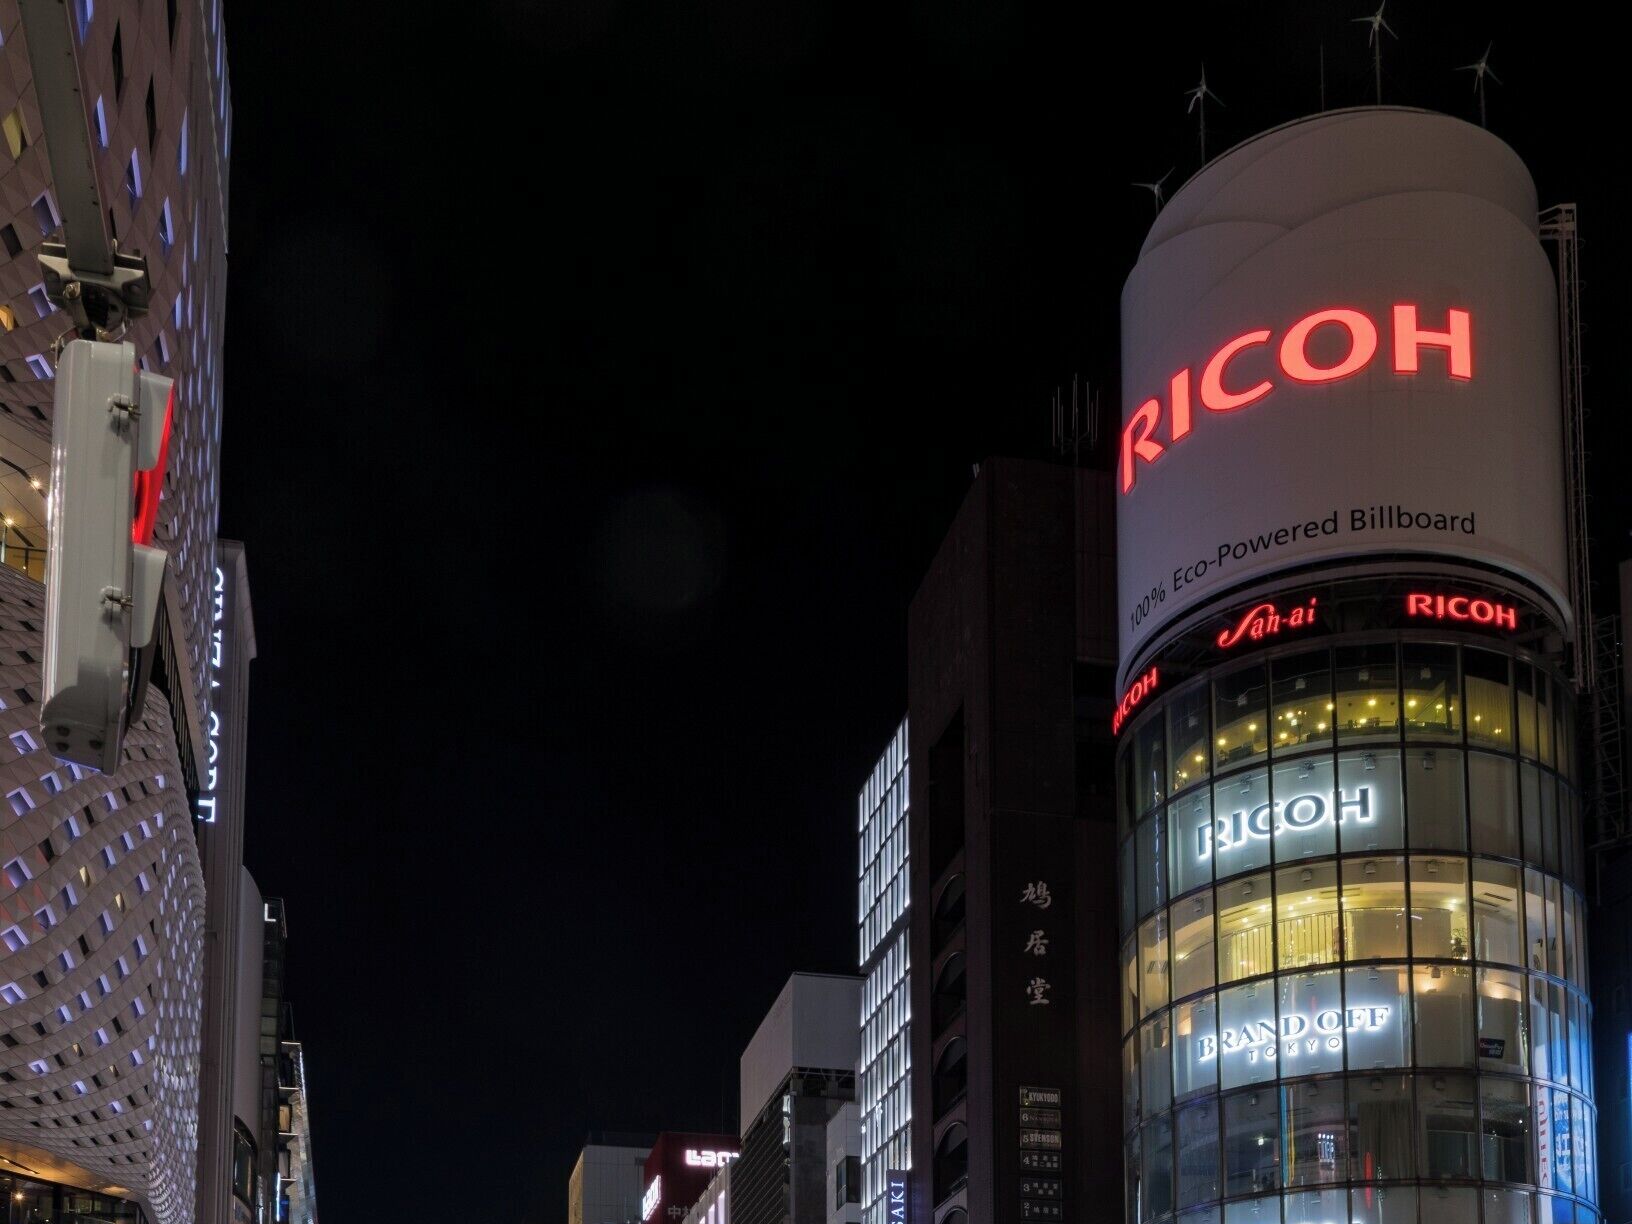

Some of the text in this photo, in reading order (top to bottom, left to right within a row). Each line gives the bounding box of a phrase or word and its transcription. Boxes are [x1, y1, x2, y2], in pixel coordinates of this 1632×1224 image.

[1121, 304, 1472, 496] RICOH
[1130, 506, 1476, 633] 100% Eco-Powered Billboard
[1408, 593, 1517, 630] RICOH
[1112, 666, 1159, 735] RICOH
[1198, 786, 1375, 858] RICOH
[1019, 880, 1052, 1006] 鳩居堂
[1198, 1006, 1390, 1061] BRAND OFF
[1247, 1036, 1343, 1063] TOKYO
[1022, 1113, 1028, 1121] 6
[1023, 1135, 1029, 1143] 5
[1023, 1156, 1030, 1165] 4
[1023, 1183, 1029, 1192] 3
